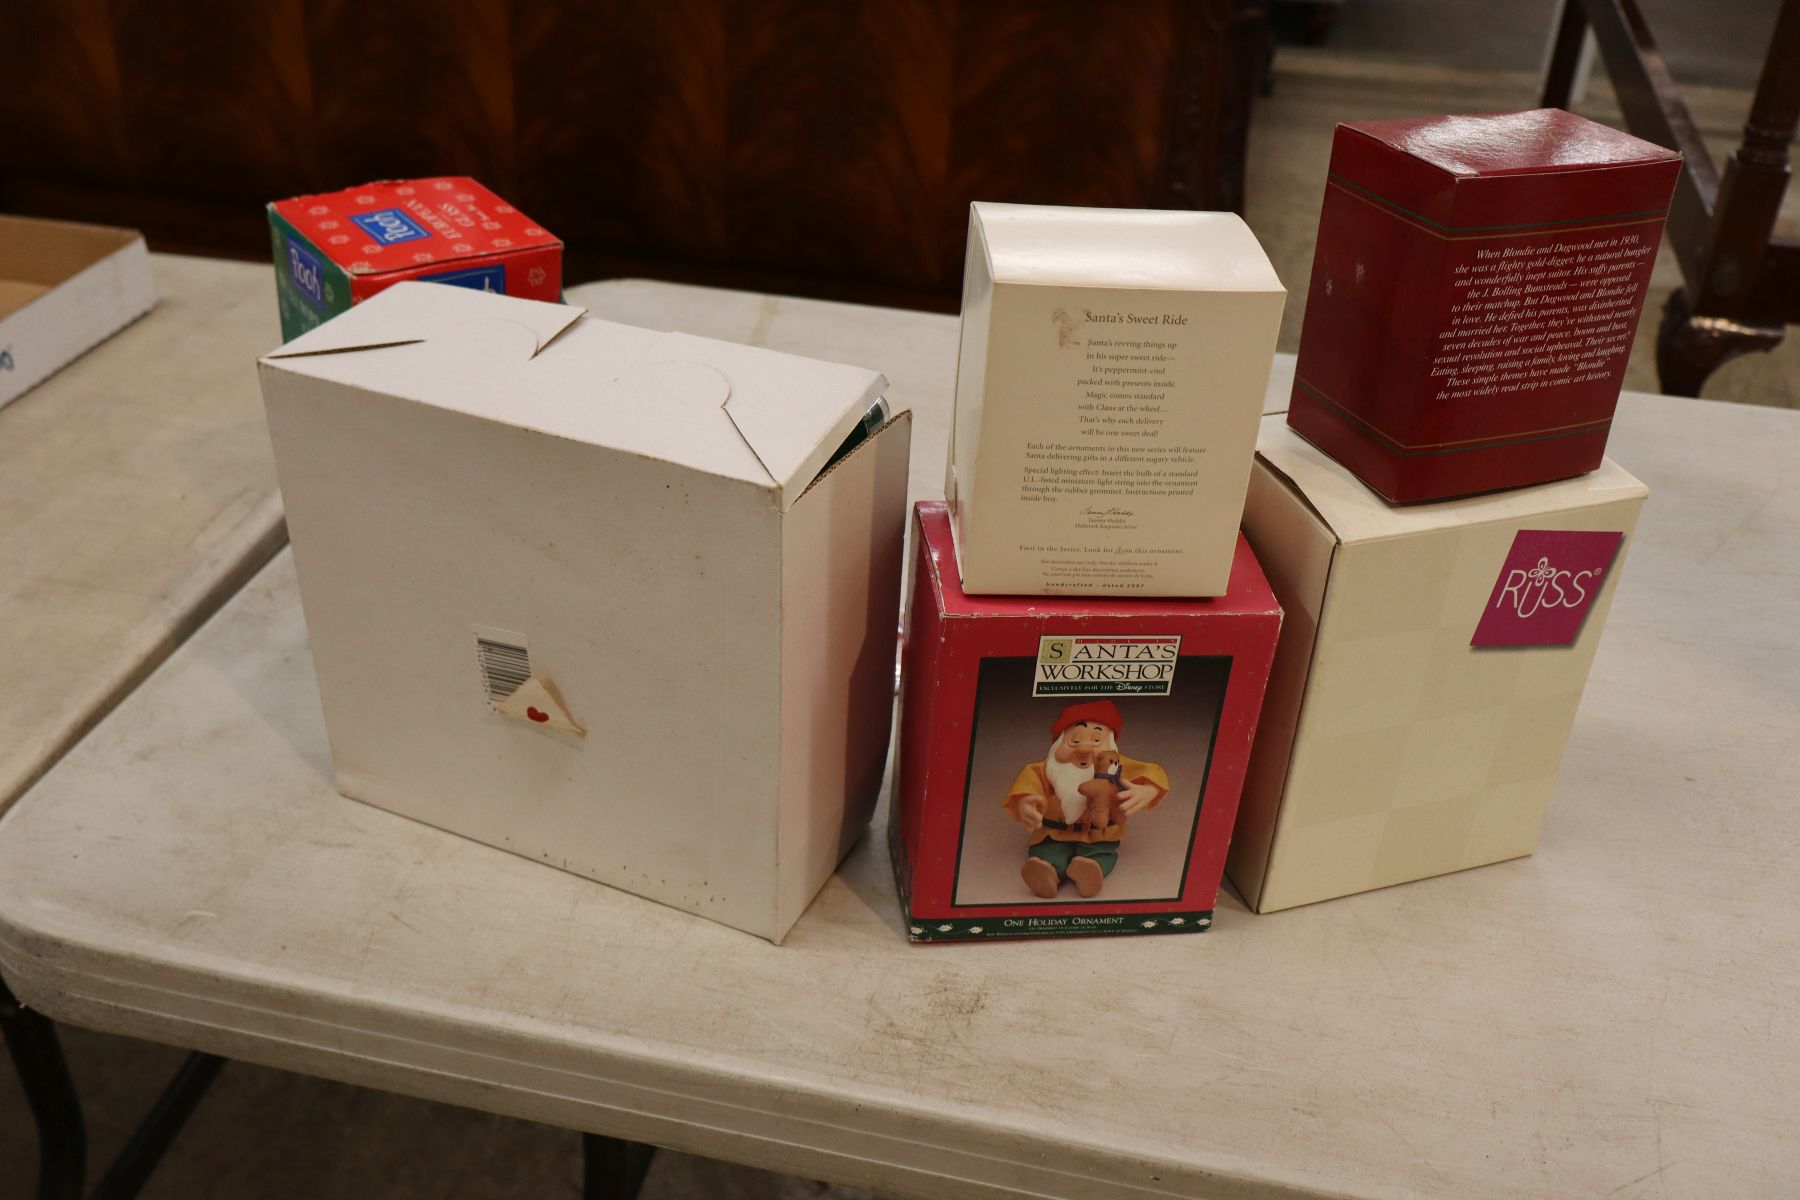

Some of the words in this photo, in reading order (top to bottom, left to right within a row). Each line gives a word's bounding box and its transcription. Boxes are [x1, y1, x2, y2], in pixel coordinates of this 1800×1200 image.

[1477, 250, 1500, 260] When
[1502, 246, 1535, 257] Blondie
[1537, 244, 1554, 254] and
[1554, 240, 1594, 253] Dagwood
[1594, 239, 1609, 248] met
[1610, 238, 1618, 246] in
[1454, 264, 1469, 274] she
[1497, 260, 1525, 272] flighty
[1576, 254, 1587, 262] he
[1595, 248, 1622, 259] natural
[1455, 277, 1473, 287] and
[1474, 272, 1522, 285] wonderfully
[1525, 271, 1546, 281] inept
[1574, 267, 1587, 276] His
[1608, 261, 1636, 273] parents
[1467, 289, 1482, 299] the
[1492, 287, 1522, 297] Bolling
[1600, 272, 1631, 284] opposed
[1462, 302, 1483, 311] their
[1524, 297, 1538, 305] But
[1540, 292, 1579, 303] Dagwood
[1580, 289, 1596, 299] and
[1596, 285, 1625, 298] Blondie
[1625, 283, 1638, 295] fell
[1085, 312, 1123, 323] Santa's
[1127, 313, 1158, 324] Sweet
[1162, 314, 1188, 325] Ride
[1439, 329, 1457, 338] and
[1458, 327, 1492, 336] married
[1577, 311, 1614, 323] withstood
[1614, 307, 1636, 318] nearly
[1452, 316, 1460, 325] in
[1485, 313, 1495, 321] He
[1499, 308, 1524, 321] defied
[1525, 309, 1537, 317] his
[1088, 339, 1112, 347] Santa's
[1114, 340, 1141, 349] revving
[1143, 340, 1165, 349] things
[1442, 343, 1466, 351] seven
[1468, 339, 1501, 348] decades
[1502, 335, 1513, 347] of
[1530, 331, 1547, 341] and
[1574, 328, 1595, 336] boom
[1596, 323, 1611, 332] and
[1433, 353, 1461, 364] sexual
[1462, 351, 1503, 361] revolution
[1504, 346, 1521, 356] and
[1521, 344, 1546, 354] social
[1585, 337, 1604, 346] Their
[1497, 360, 1524, 369] raising
[1559, 353, 1580, 363] loving
[1581, 349, 1597, 357] and
[1436, 391, 1449, 400] the
[1451, 389, 1472, 398] most
[1473, 385, 1500, 395] widely
[1501, 382, 1520, 392] read
[1521, 381, 1538, 390] strip
[1550, 377, 1572, 385] comic
[1574, 374, 1585, 382] art
[1447, 378, 1470, 387] These
[1472, 374, 1498, 384] simple
[1500, 371, 1528, 381] themes
[1529, 368, 1548, 377] have
[1549, 365, 1570, 374] made
[1136, 418, 1163, 426] delivery
[1024, 466, 1048, 474] Special
[1496, 570, 1592, 618] RUSS
[1049, 642, 1177, 660] SANTA'S
[1040, 664, 1174, 680] WORKSHOP
[1115, 682, 1142, 692] Disney
[1072, 917, 1124, 925] ORNAMENT
